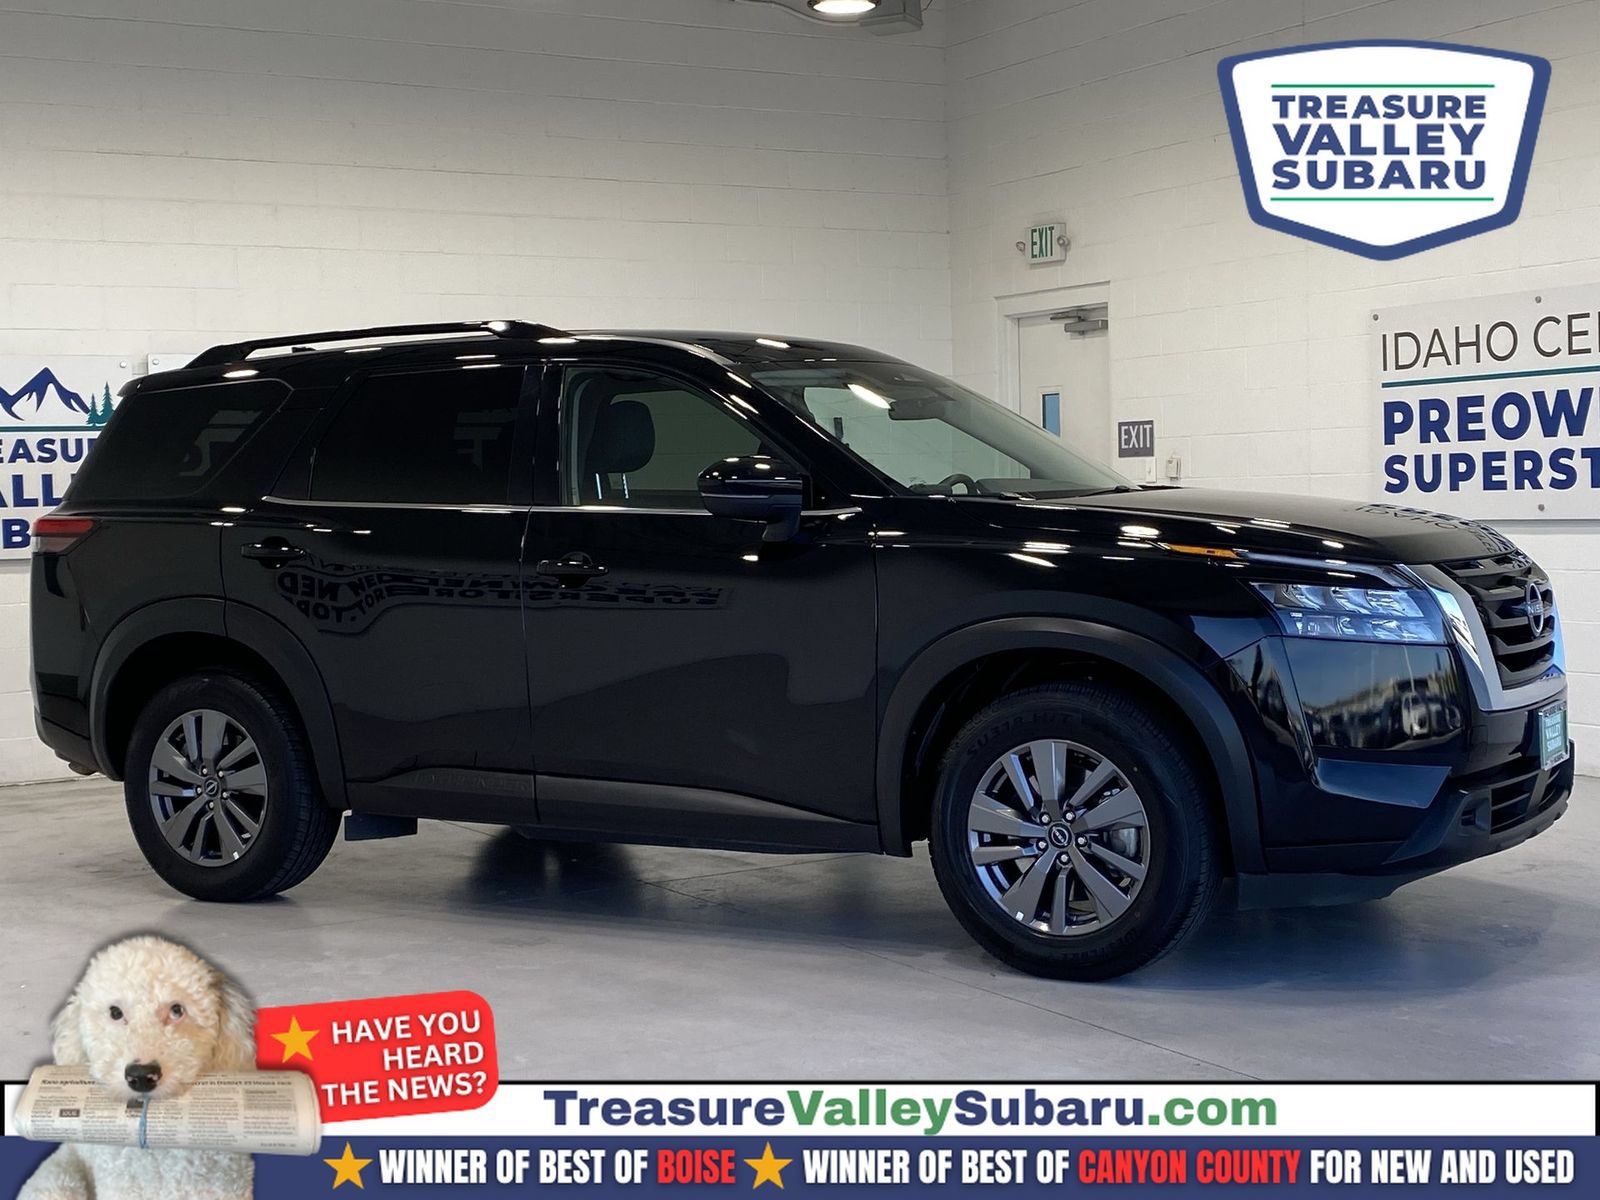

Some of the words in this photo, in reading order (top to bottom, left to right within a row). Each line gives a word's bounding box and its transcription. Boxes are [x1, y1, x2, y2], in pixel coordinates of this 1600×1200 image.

[1030, 226, 1055, 259] EXIT
[1382, 321, 1519, 371] IDAHO
[1533, 311, 1600, 358] CE
[1383, 387, 1600, 445] PREOW
[0, 438, 97, 463] ASU
[1120, 424, 1152, 449] EXIT
[1384, 447, 1600, 493] SUPERST
[0, 473, 78, 507] LL
